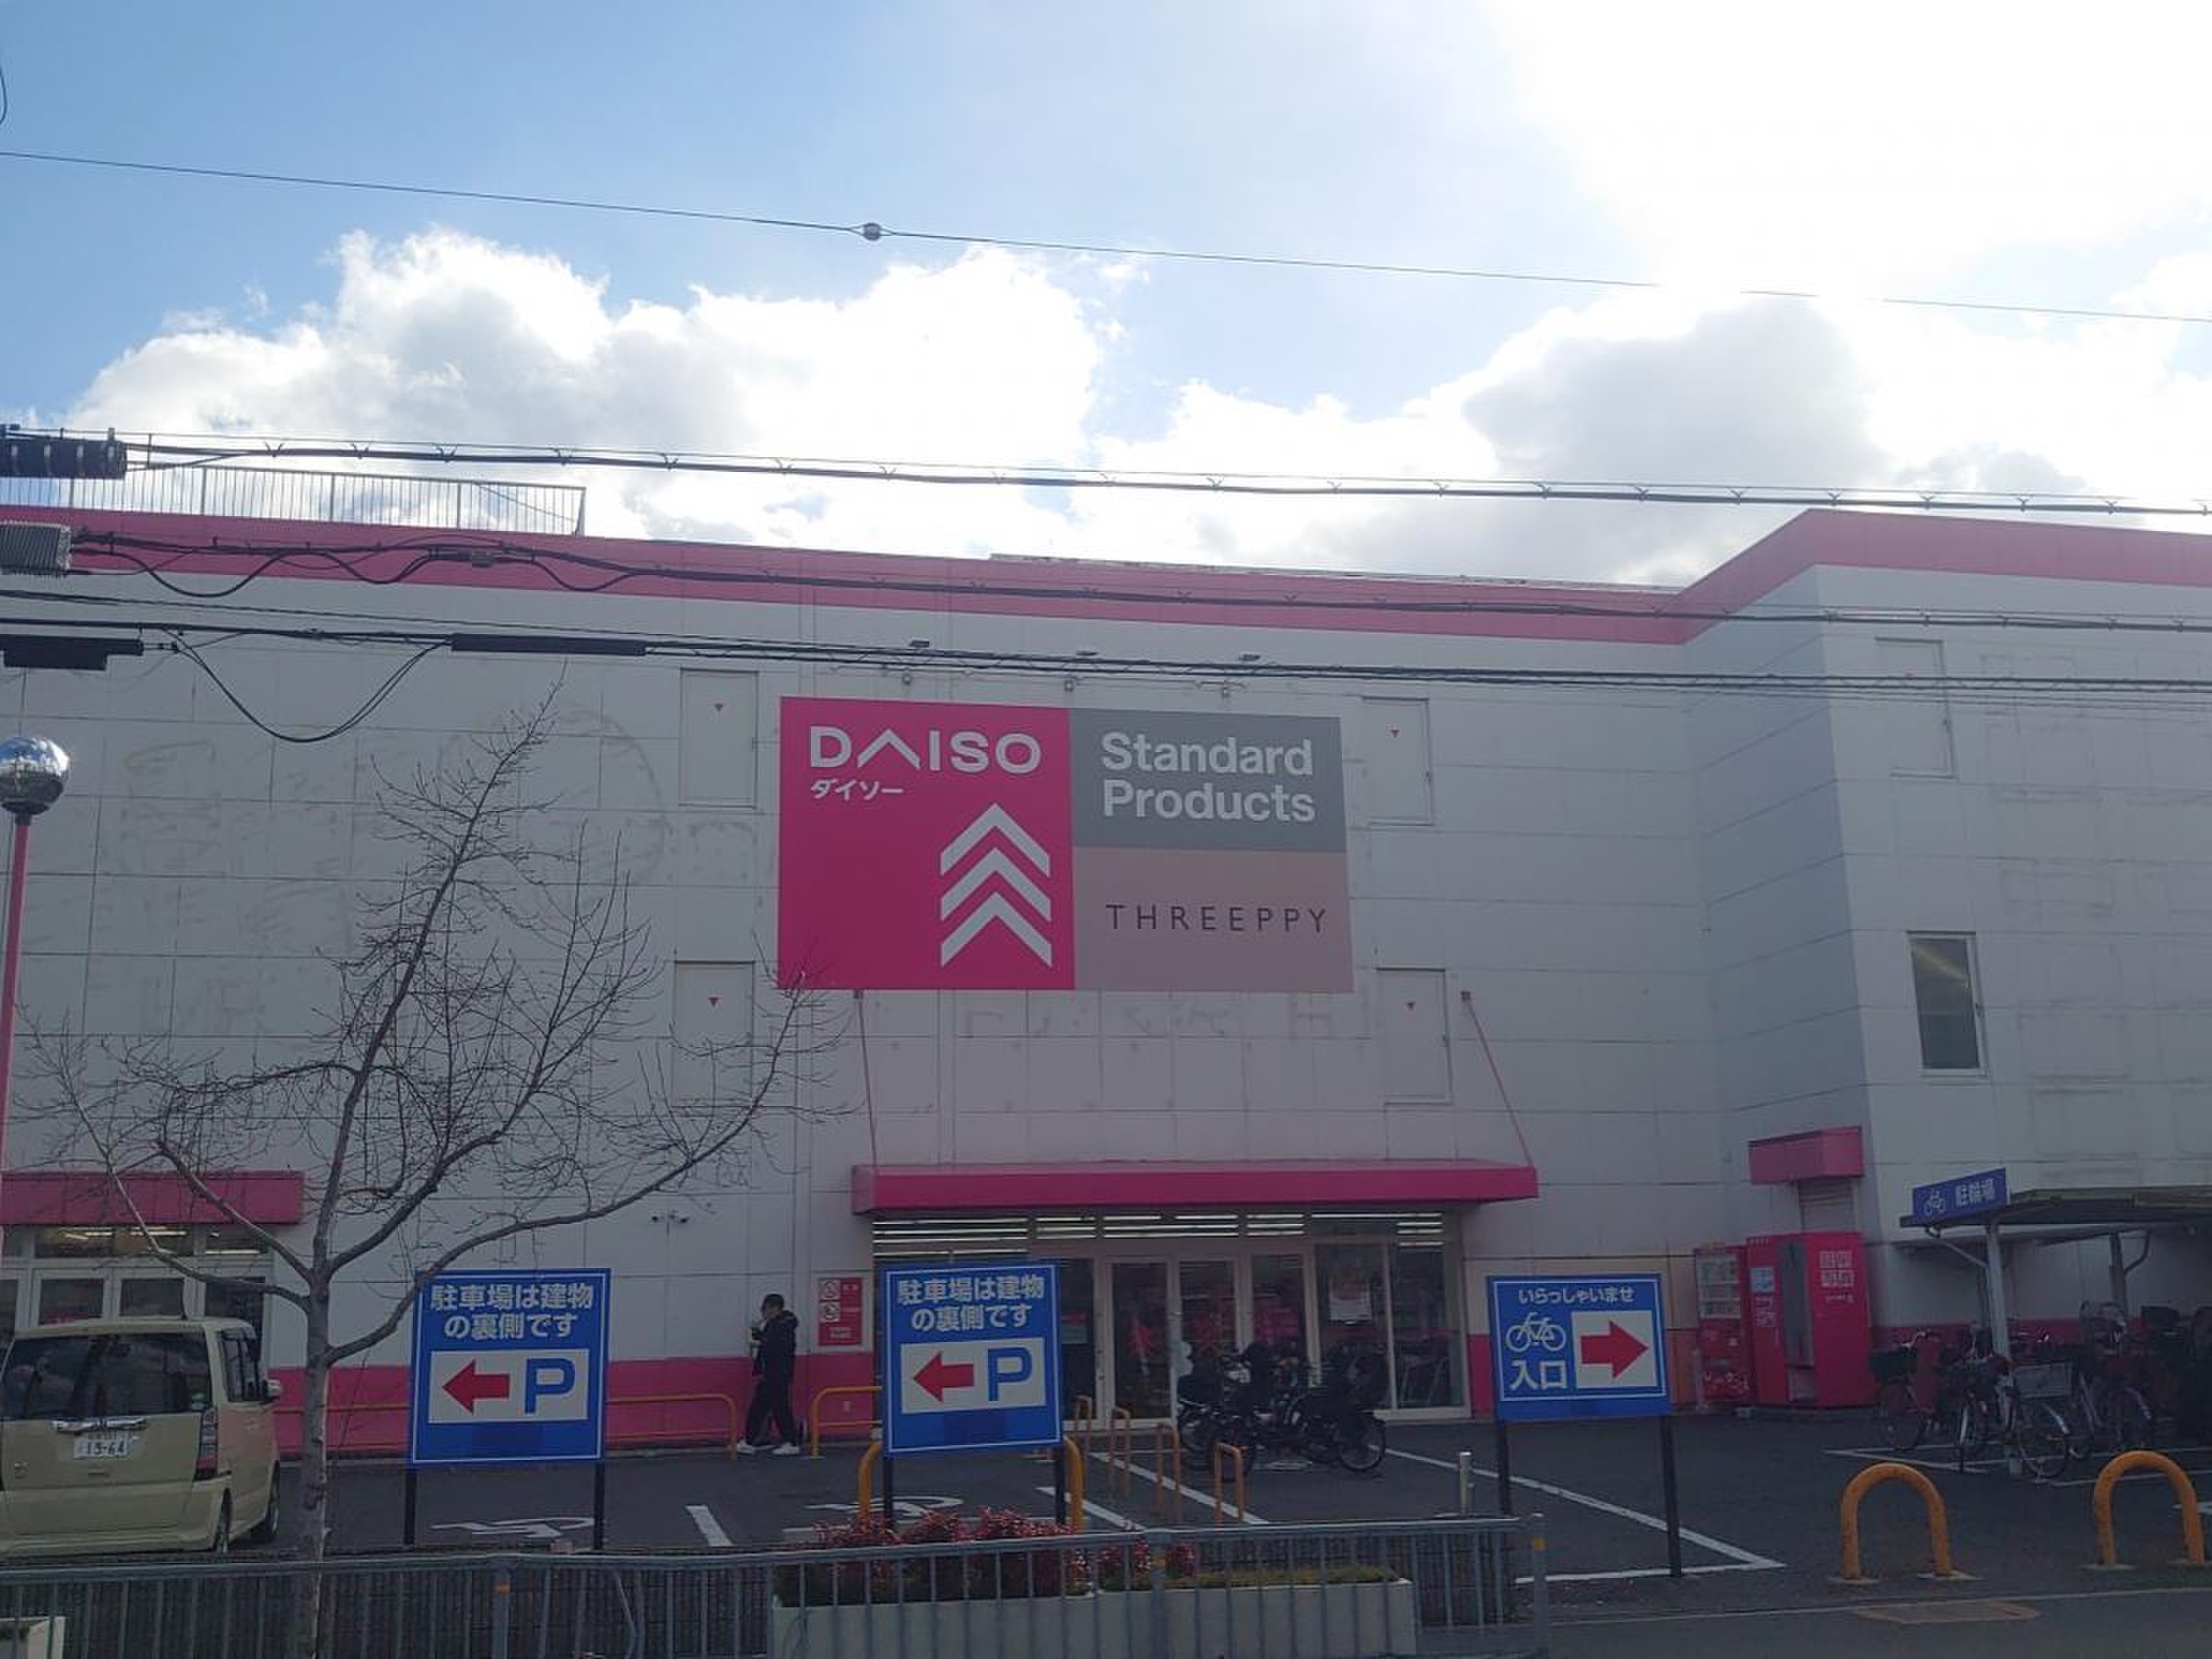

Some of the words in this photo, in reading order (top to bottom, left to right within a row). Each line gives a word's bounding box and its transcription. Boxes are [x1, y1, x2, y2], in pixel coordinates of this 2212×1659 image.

[810, 725, 1041, 774] DAISO
[1101, 732, 1313, 776] Standard
[811, 779, 904, 801] ダイソー
[1103, 779, 1316, 822] Products
[1105, 904, 1326, 933] THREEPPY
[430, 1283, 594, 1311] 駐車場は建物
[898, 1274, 1045, 1305] 駐車場は建物
[1518, 1285, 1635, 1304] いらっしゃいませ
[443, 1312, 578, 1340] の裏側です
[911, 1302, 1033, 1332] の裏側です
[524, 1358, 576, 1415] P
[987, 1347, 1033, 1402] P
[1509, 1359, 1567, 1390] 入口
